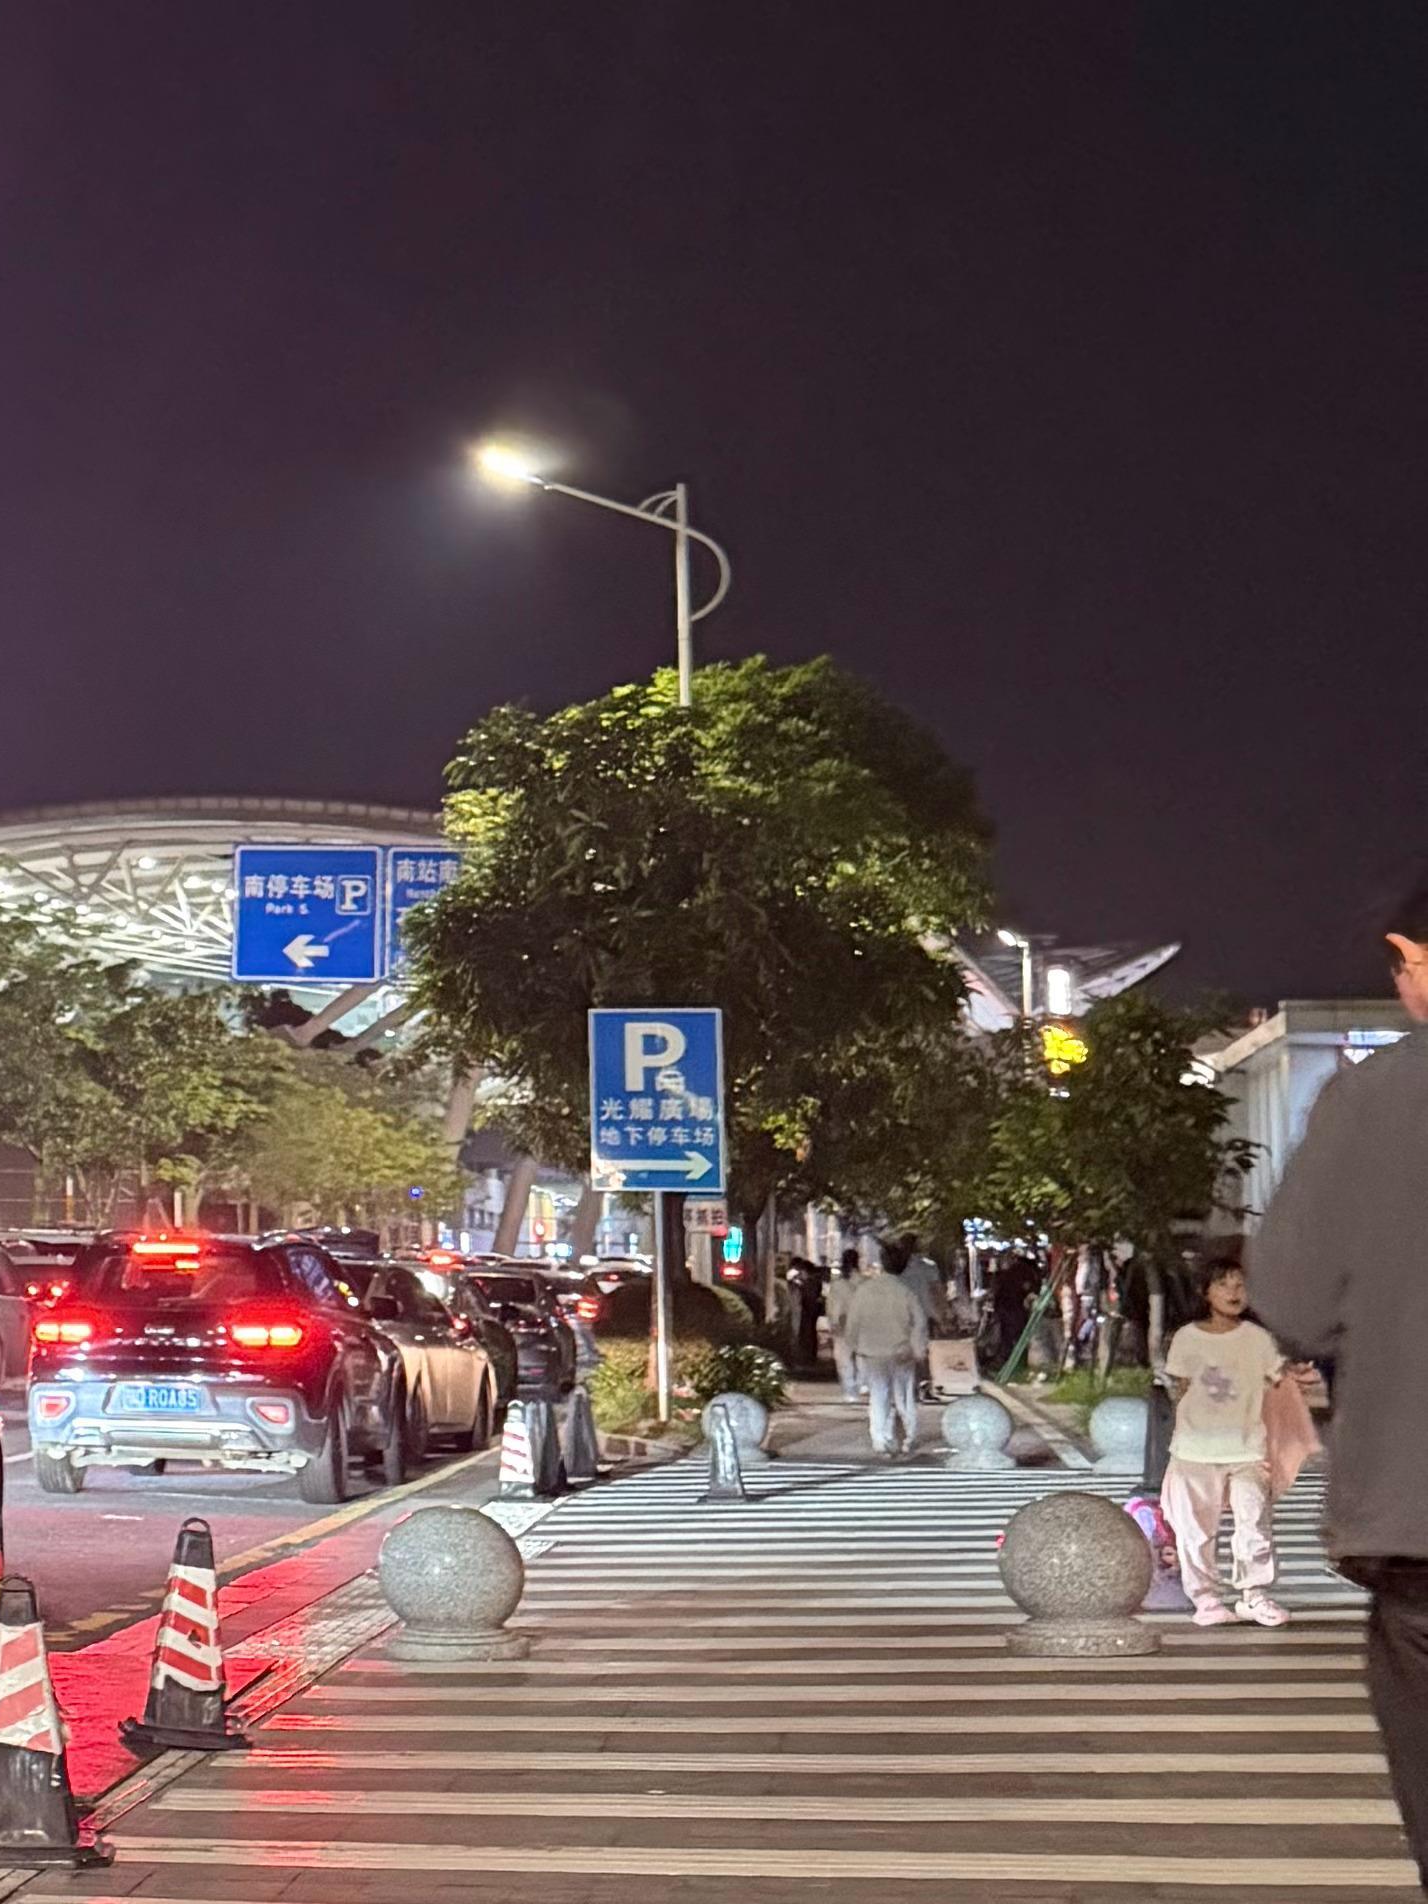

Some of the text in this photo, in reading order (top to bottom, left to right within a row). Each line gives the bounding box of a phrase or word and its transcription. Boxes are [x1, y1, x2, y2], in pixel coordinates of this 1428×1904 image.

[245, 874, 367, 911] 南停车场 P
[624, 1022, 686, 1092] P
[600, 1126, 714, 1146] 地下停车场
